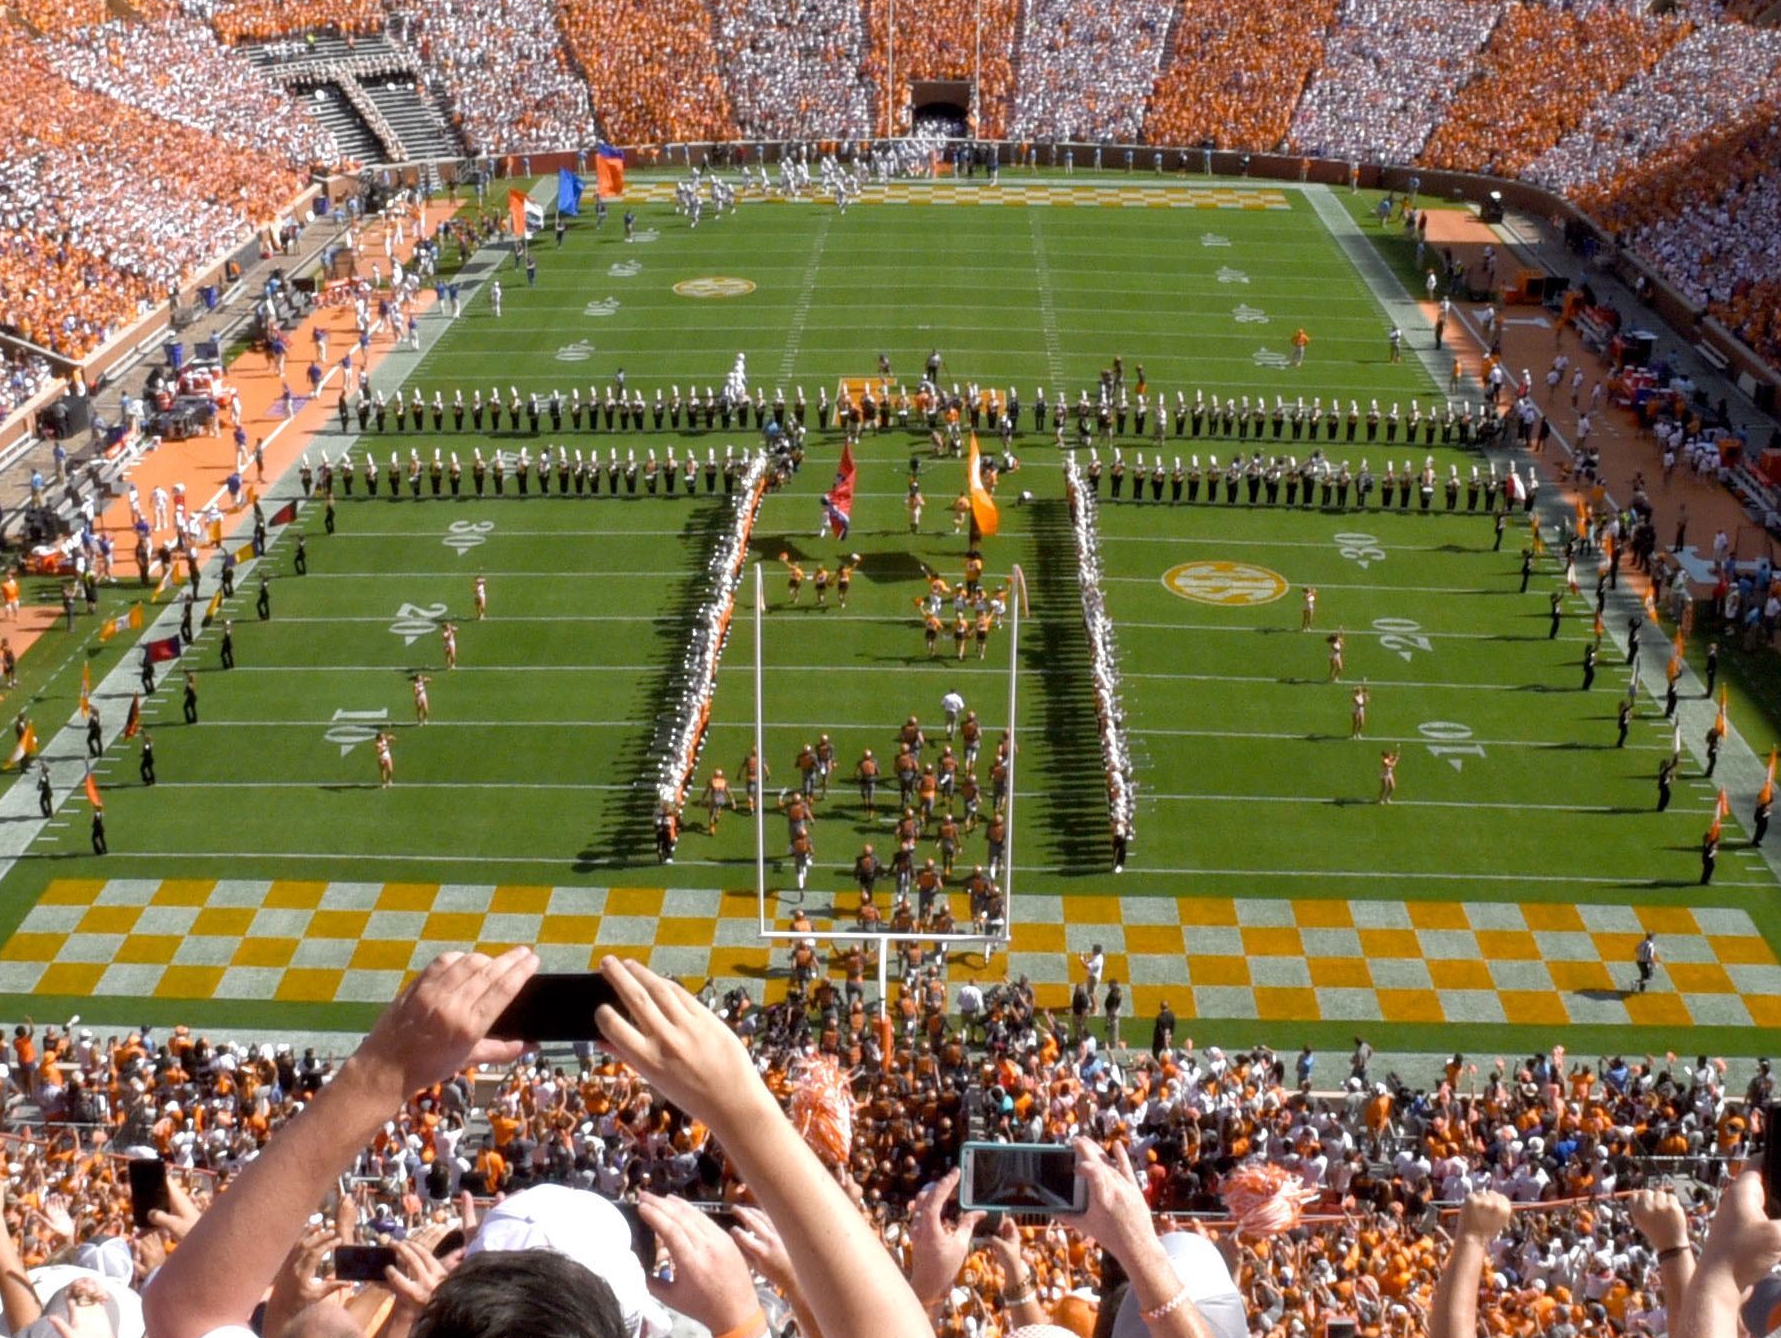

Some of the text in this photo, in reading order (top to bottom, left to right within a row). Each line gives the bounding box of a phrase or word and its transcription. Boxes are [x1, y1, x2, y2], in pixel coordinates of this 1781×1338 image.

[442, 519, 495, 549] 30
[1334, 532, 1387, 562] 30
[388, 602, 448, 636] 20
[1372, 617, 1433, 652] 20
[324, 708, 389, 744] 10
[1417, 721, 1487, 759] 10
